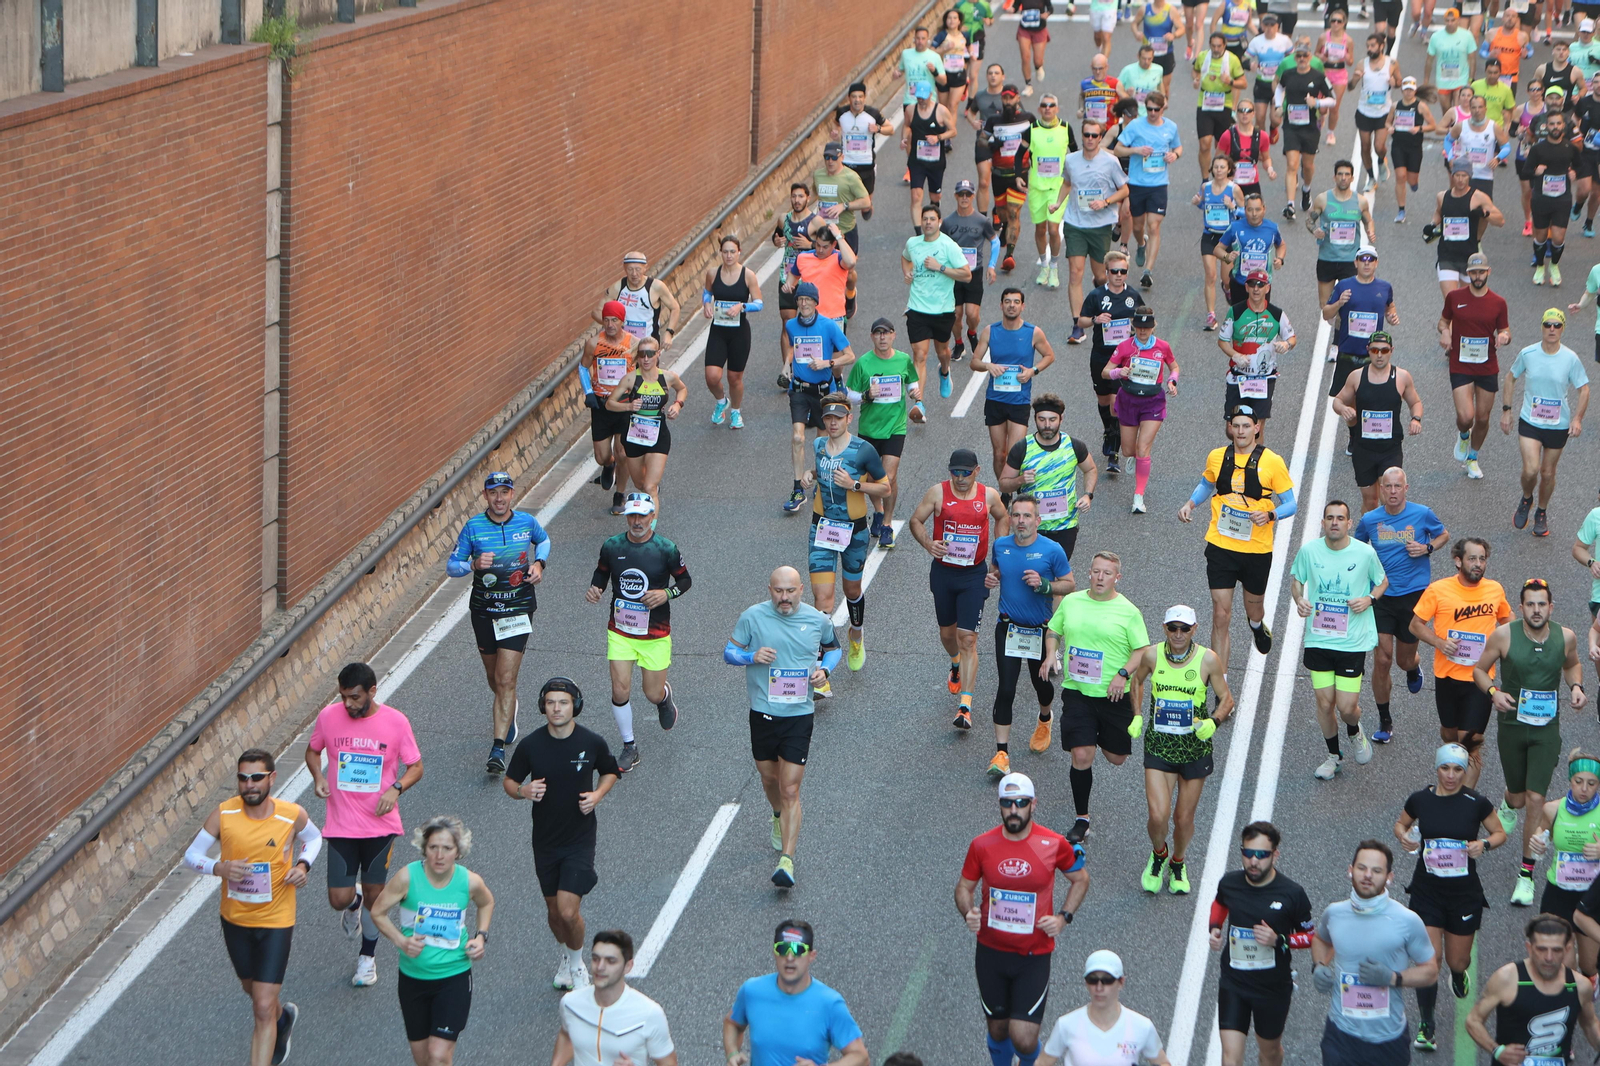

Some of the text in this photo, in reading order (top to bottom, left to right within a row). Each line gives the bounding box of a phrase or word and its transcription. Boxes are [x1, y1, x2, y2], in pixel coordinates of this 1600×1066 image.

[959, 224, 978, 233] asics
[1101, 301, 1112, 310] 77
[1454, 604, 1494, 621] VAMOS
[434, 910, 458, 918] ZURICH
